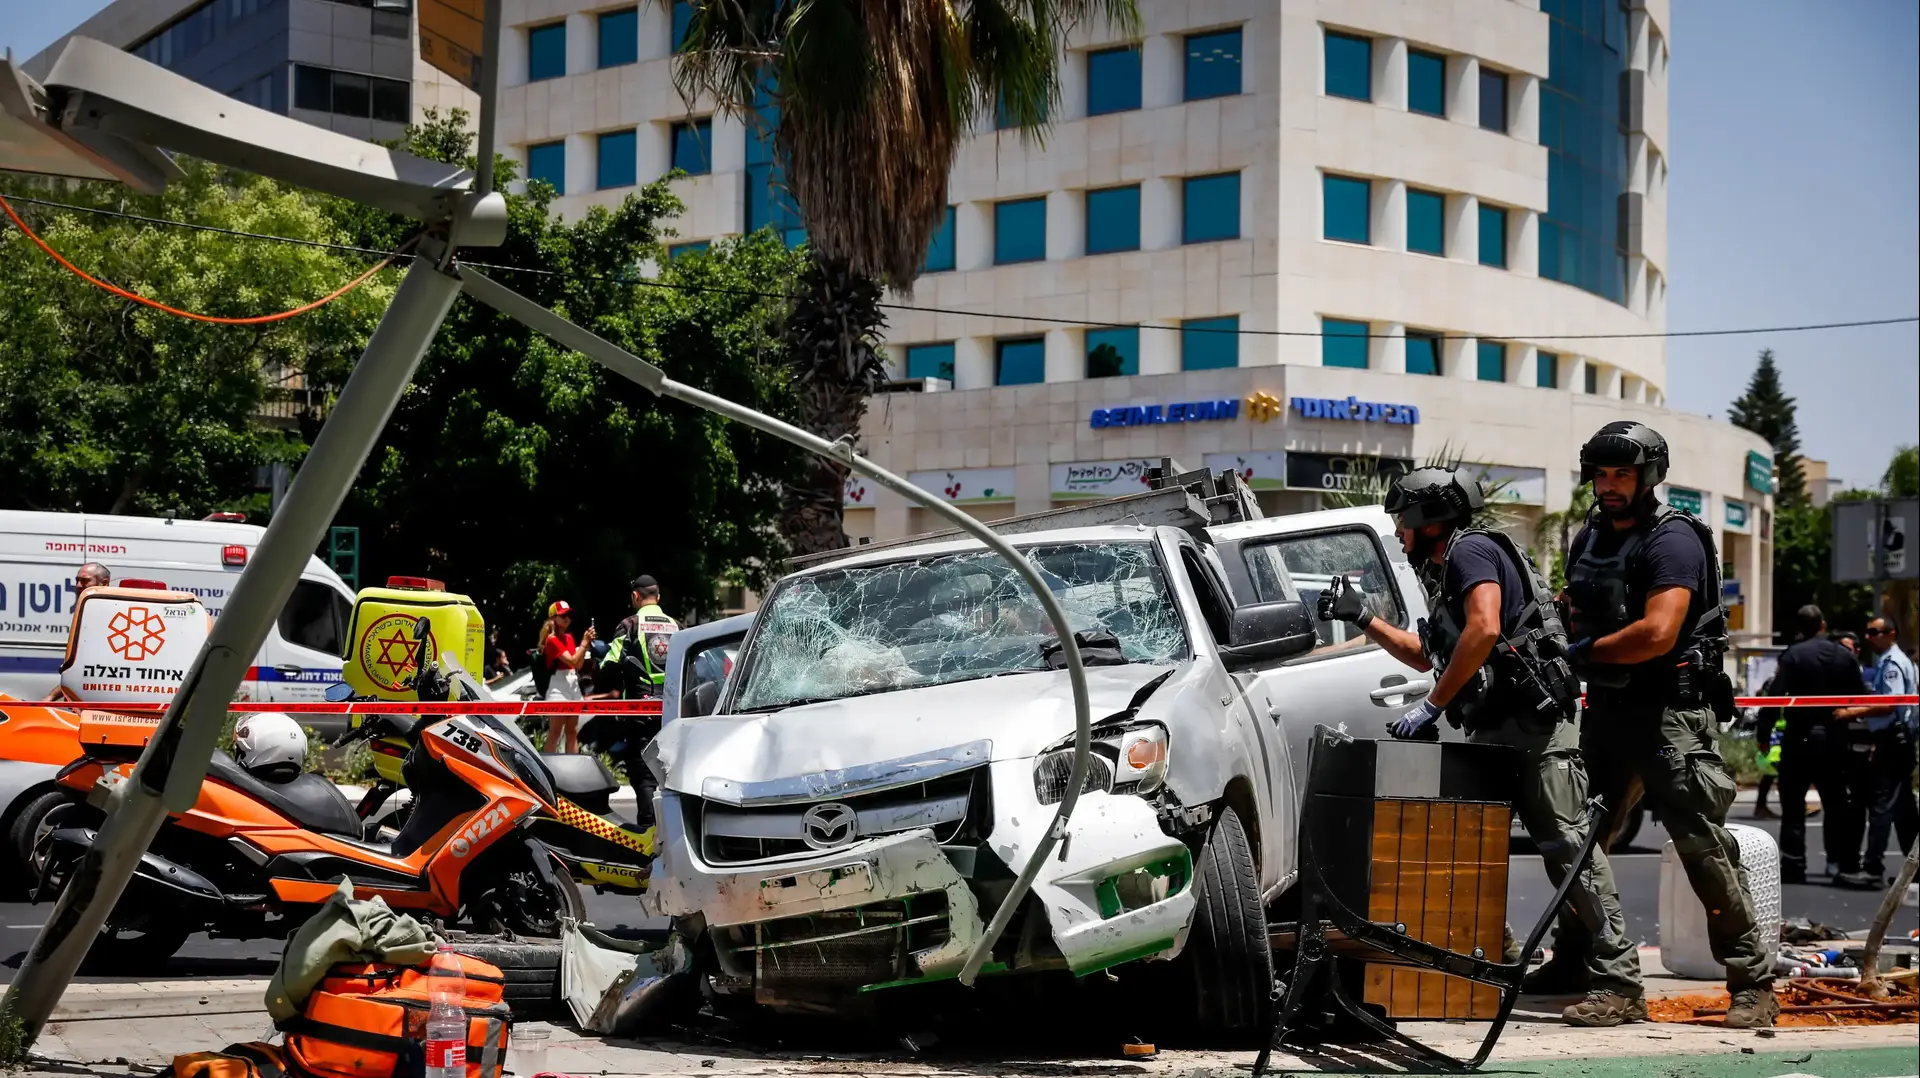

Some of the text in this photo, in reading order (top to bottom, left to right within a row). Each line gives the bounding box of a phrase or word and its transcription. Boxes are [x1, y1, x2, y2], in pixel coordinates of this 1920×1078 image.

[1090, 399, 1240, 429] BEINLEUMI
[1291, 396, 1419, 424] הבינלאומי
[45, 542, 126, 554] רפואה דחופה
[46, 624, 70, 634] רותי
[83, 664, 184, 681] איחוד הצלה
[365, 643, 390, 685] MAGEN DAVID
[82, 683, 122, 692] UNITED
[442, 722, 482, 754] 738
[464, 802, 511, 844] 1221
